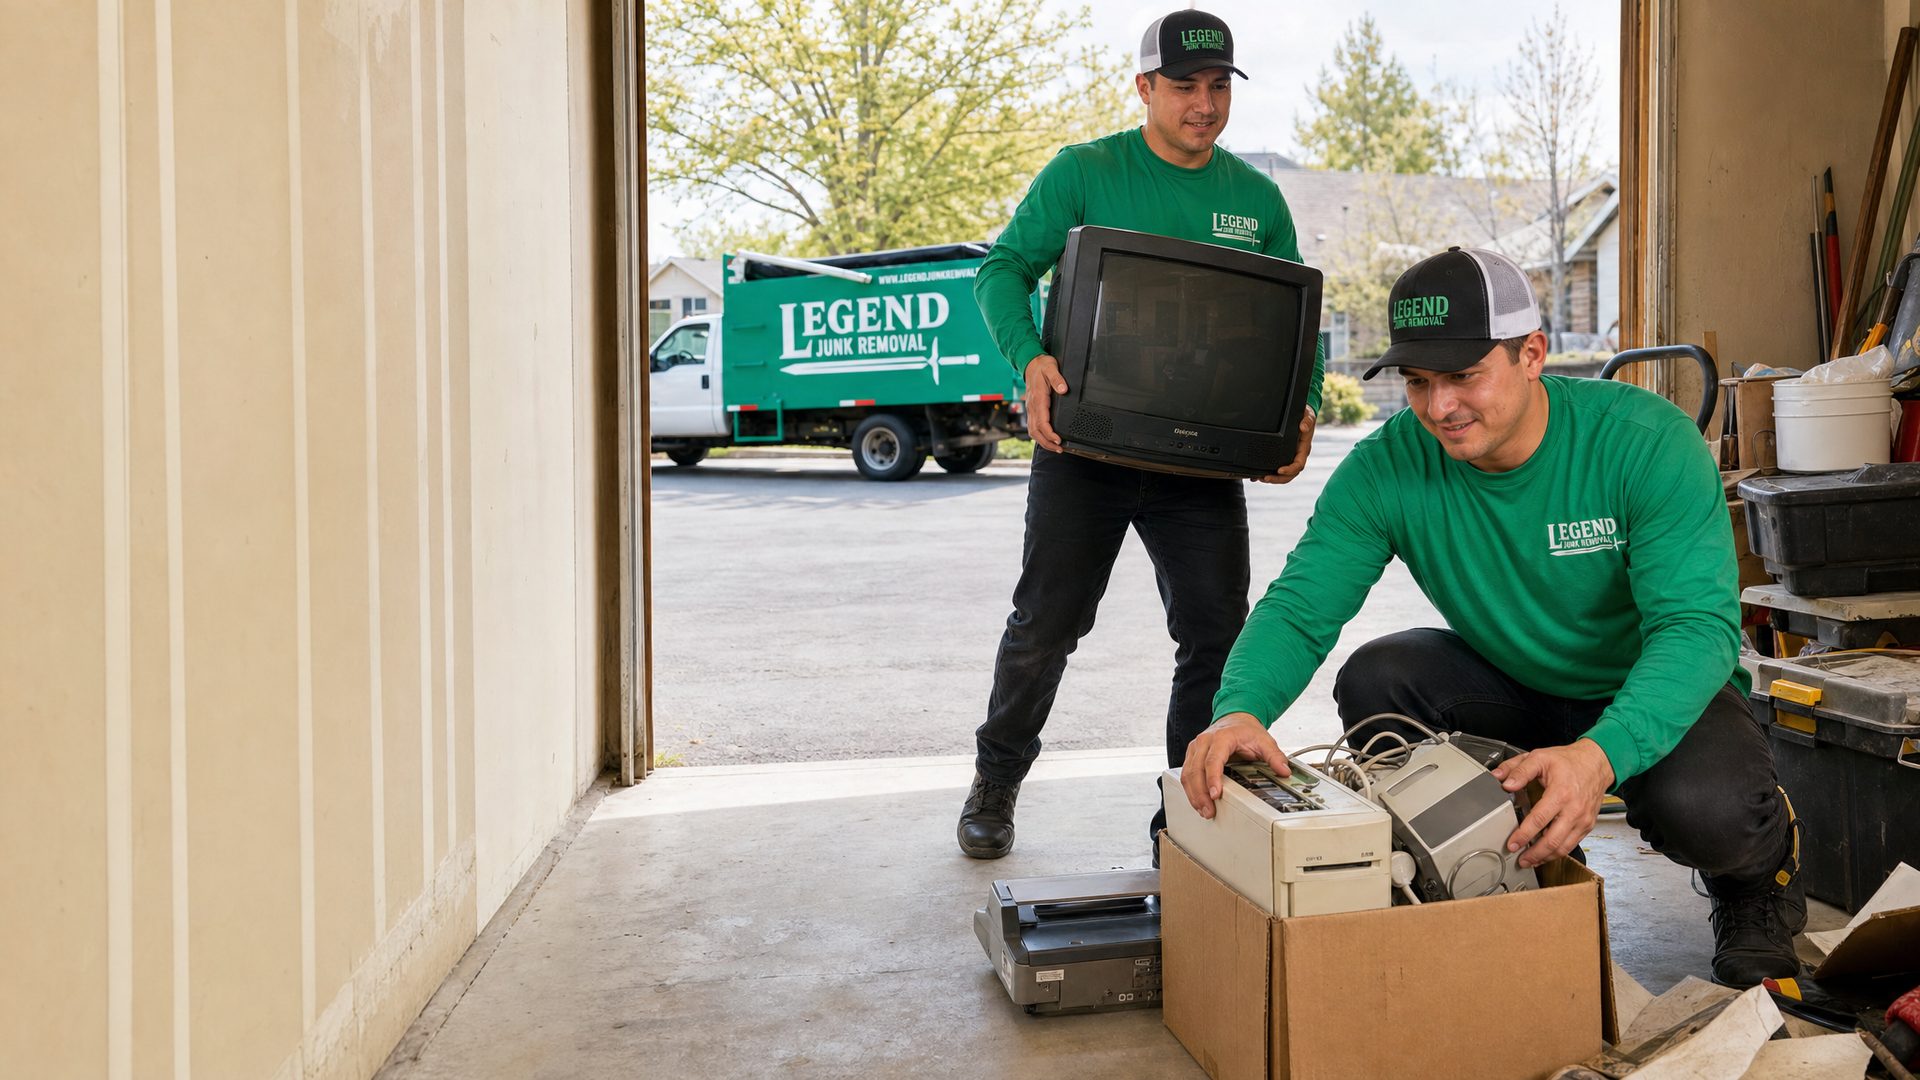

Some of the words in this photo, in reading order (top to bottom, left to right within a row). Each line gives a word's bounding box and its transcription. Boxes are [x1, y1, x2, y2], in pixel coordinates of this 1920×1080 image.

[1181, 29, 1224, 44] LEGEND
[1212, 212, 1258, 231] LEGEND
[1393, 295, 1449, 320] LEGEND
[779, 292, 949, 359] LEGEND
[1408, 315, 1445, 328] REMOVAL
[816, 337, 854, 357] JUNK
[858, 333, 927, 355] REMOVAL
[1547, 517, 1617, 549] LEGEND
